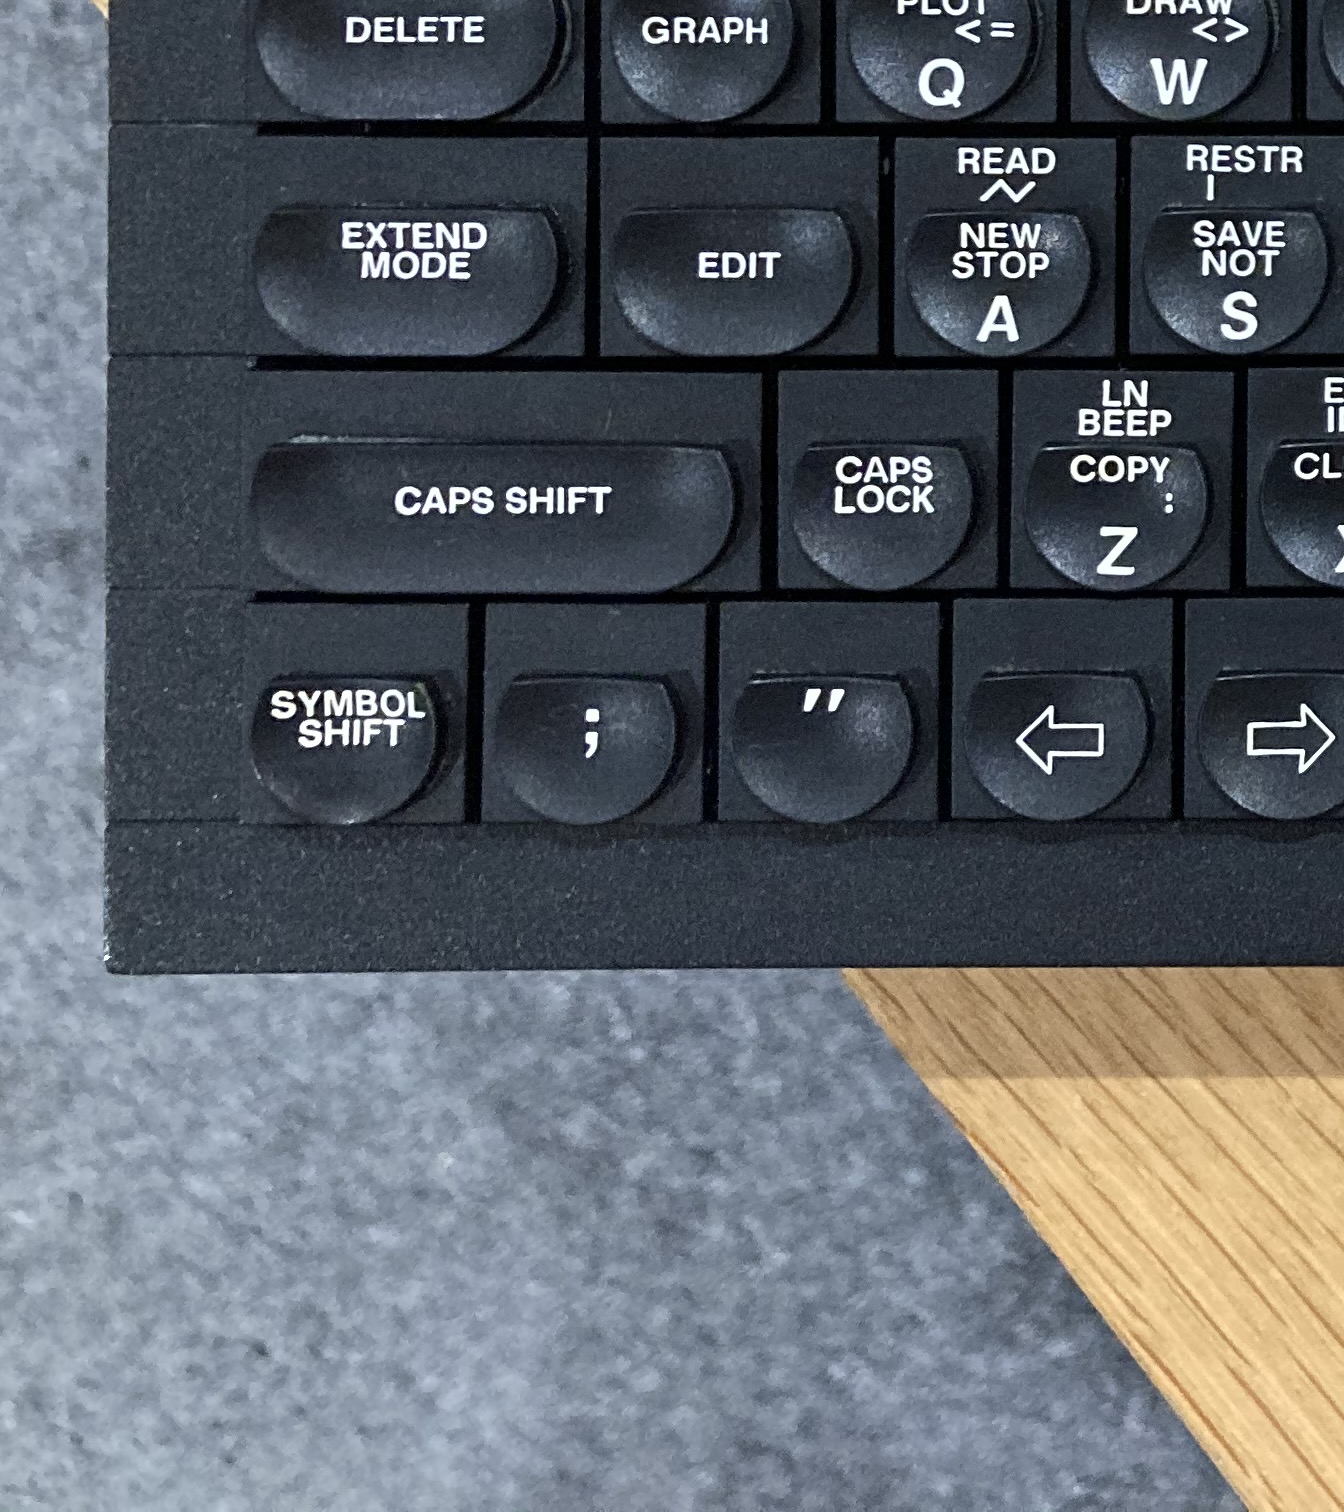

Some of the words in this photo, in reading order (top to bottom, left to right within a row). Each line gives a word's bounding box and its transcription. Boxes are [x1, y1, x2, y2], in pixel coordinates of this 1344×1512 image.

[345, 15, 485, 43] DELETE
[641, 16, 768, 45] GRAPH
[918, 57, 965, 109] Q
[1149, 57, 1208, 106] W
[957, 147, 1056, 175] READ
[1186, 144, 1303, 173] RESTR
[341, 221, 488, 250] EXTEND
[960, 222, 1042, 249] NEW
[1193, 219, 1286, 248] SAVE
[360, 250, 471, 280] MODE
[698, 251, 782, 279] EDIT
[951, 250, 1050, 279] STOP
[1201, 248, 1280, 277] NOT
[975, 294, 1020, 343] A
[1220, 290, 1258, 341] S
[1101, 379, 1149, 408] LN
[1077, 408, 1172, 437] BEEP
[835, 455, 934, 485] CAPS
[1069, 454, 1170, 484] COPY
[394, 485, 495, 516] CAPS
[505, 486, 613, 515] SHIFT
[834, 484, 935, 514] LOCK
[1096, 526, 1139, 576] Z
[270, 688, 426, 720] SYMBOL
[297, 718, 406, 749] SHIFT
